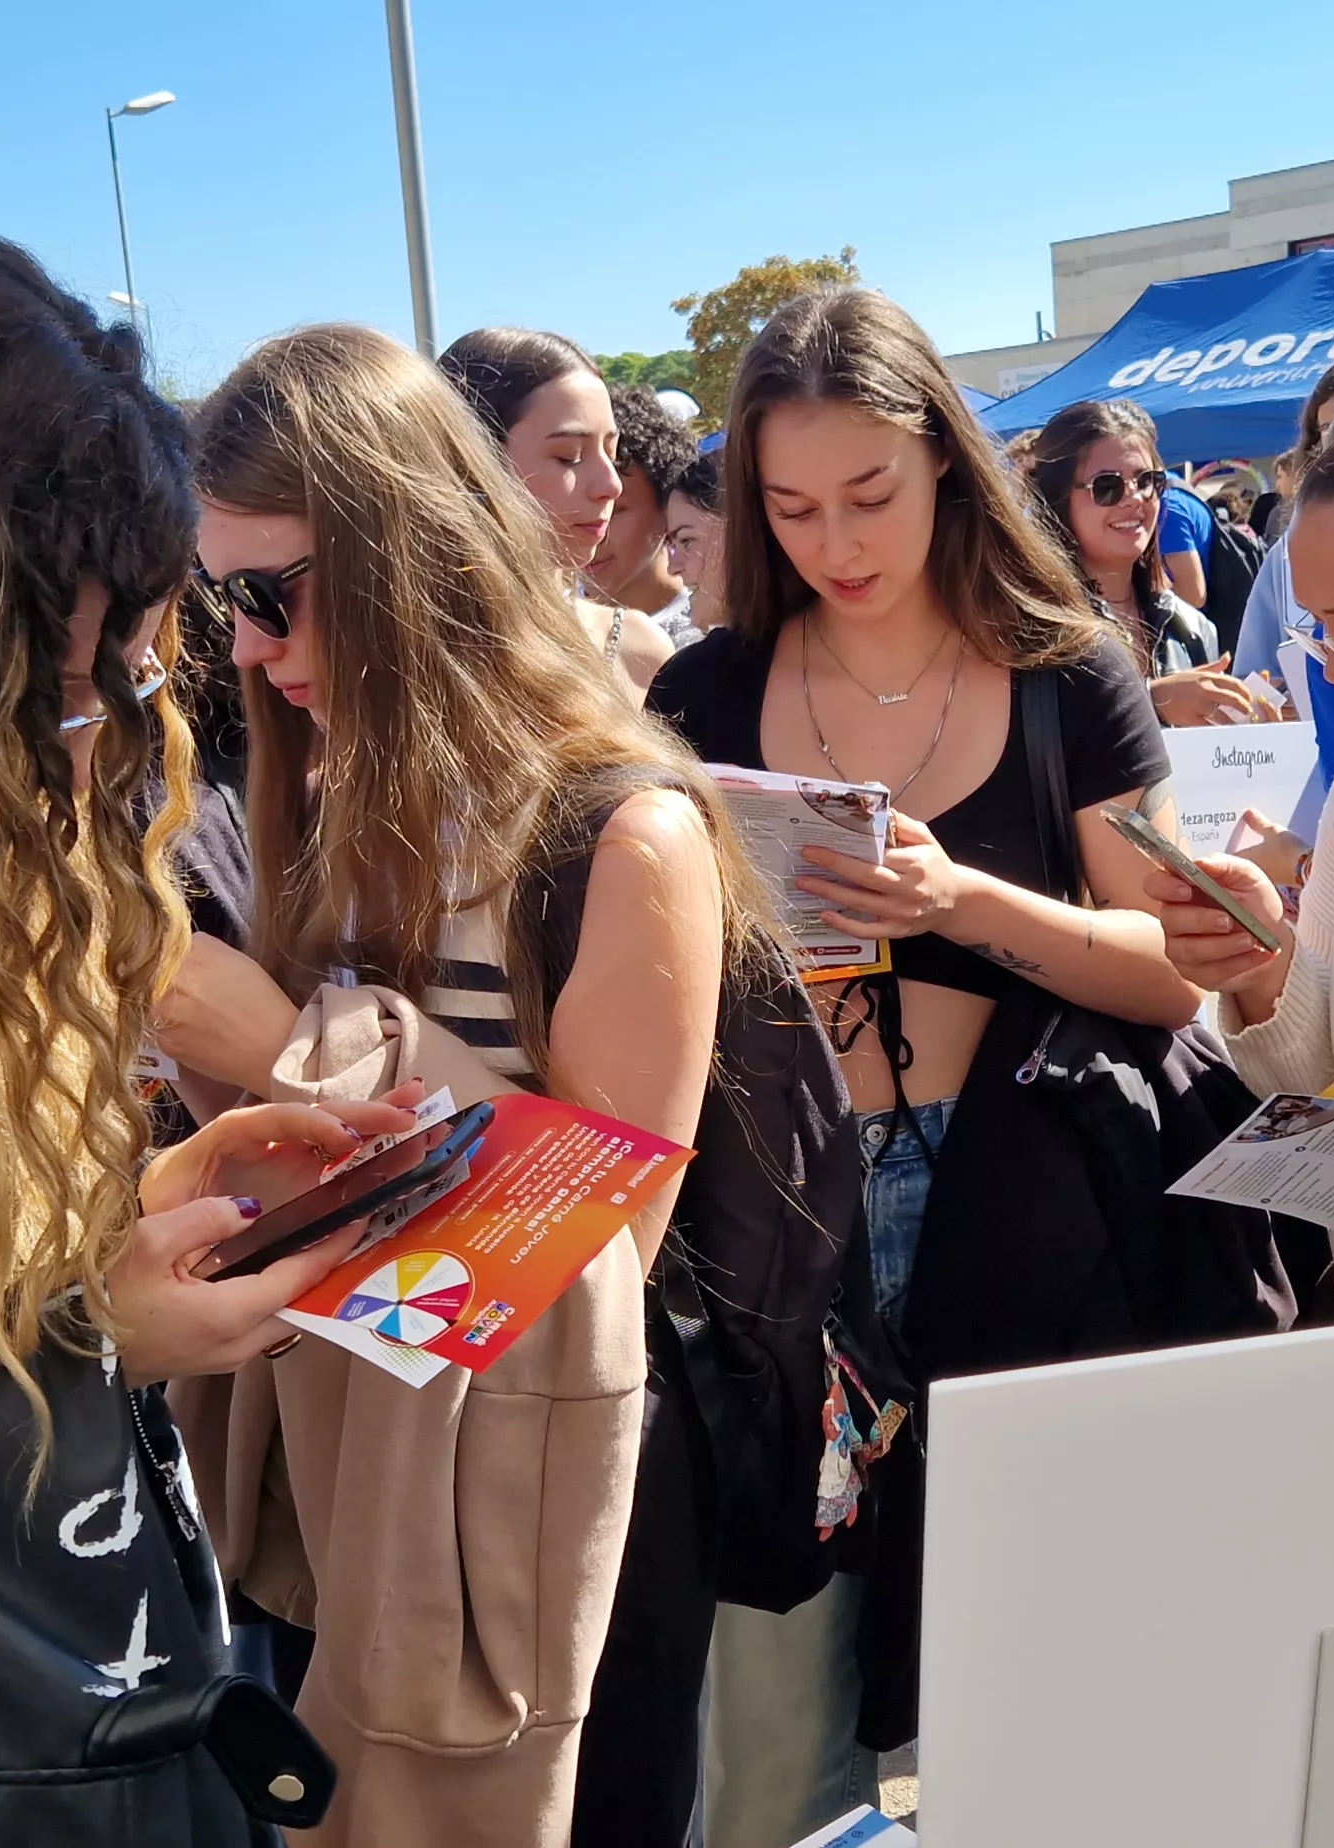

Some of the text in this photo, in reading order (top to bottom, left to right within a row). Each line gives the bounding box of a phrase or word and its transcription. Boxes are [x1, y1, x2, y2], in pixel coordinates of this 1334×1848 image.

[1212, 746, 1276, 778] Instagram
[1191, 828, 1220, 842] España
[509, 1140, 635, 1264] ¡Con tu Carné Joven
[524, 1136, 621, 1232] siempre ganas!
[464, 1302, 508, 1343] JOVEN
[474, 1306, 516, 1347] CARNÉ
